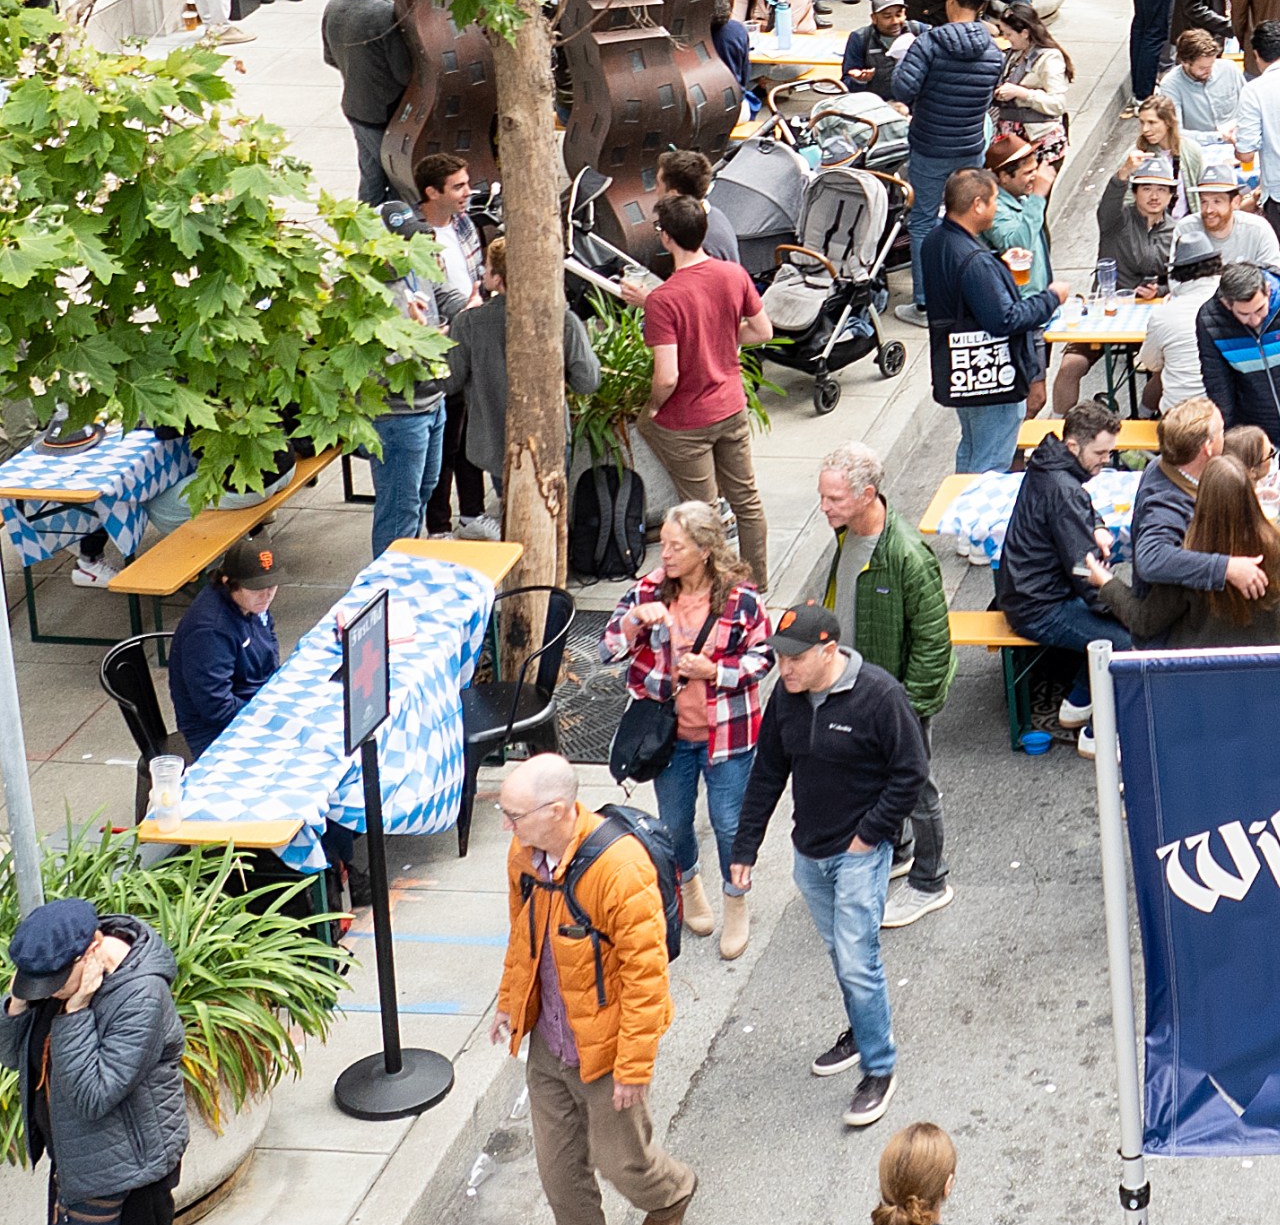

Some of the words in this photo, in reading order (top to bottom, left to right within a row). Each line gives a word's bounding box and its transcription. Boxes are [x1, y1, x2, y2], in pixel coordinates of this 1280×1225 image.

[952, 332, 992, 344] MILLA
[952, 342, 1011, 370] 日本酒
[950, 366, 998, 391] 와인
